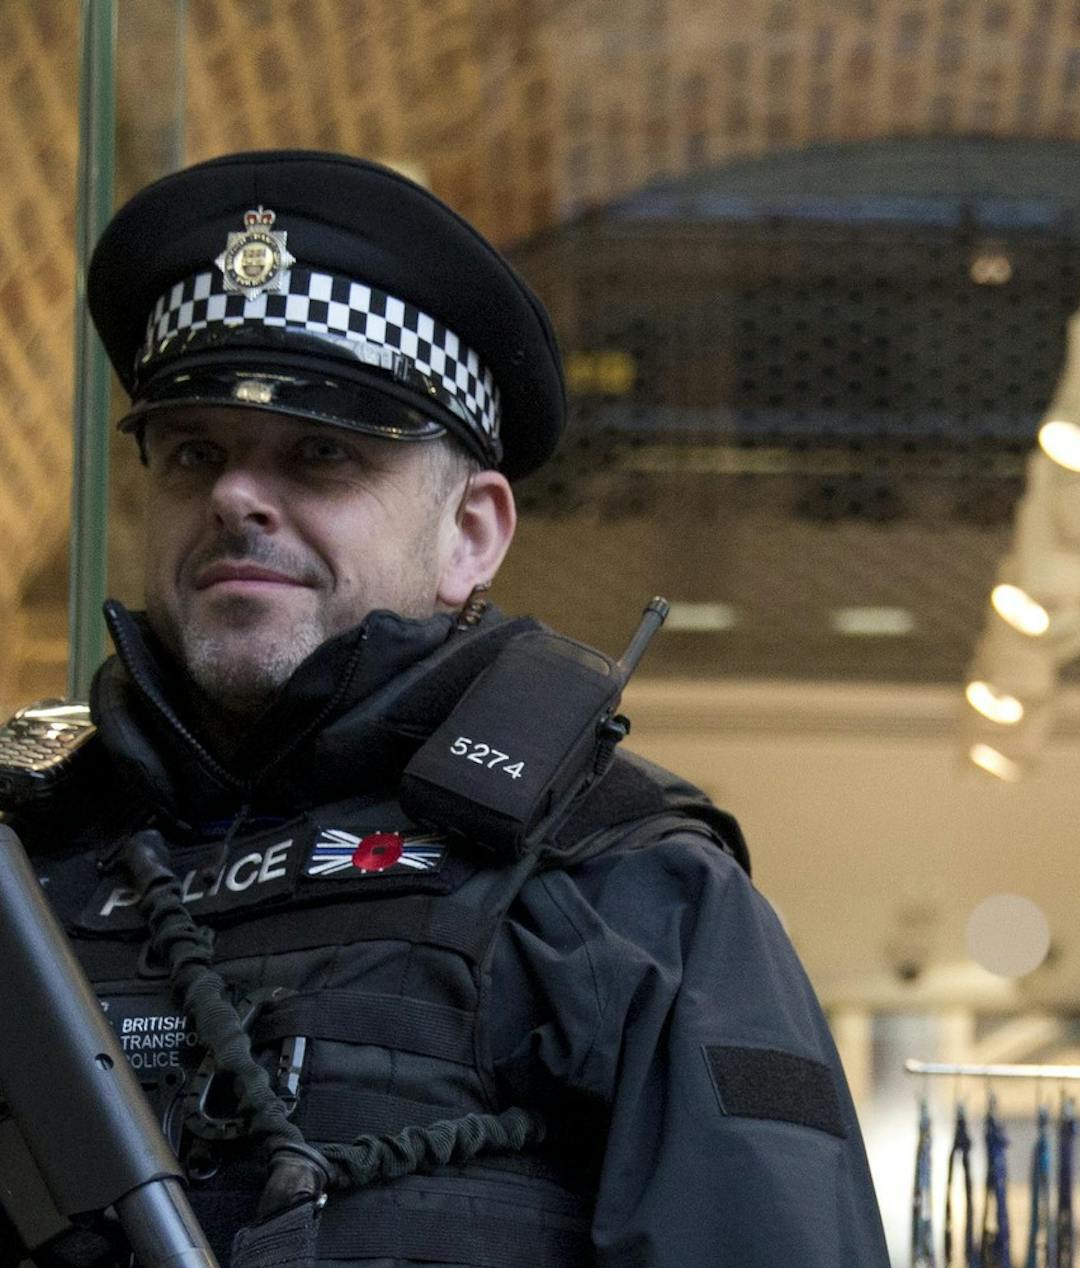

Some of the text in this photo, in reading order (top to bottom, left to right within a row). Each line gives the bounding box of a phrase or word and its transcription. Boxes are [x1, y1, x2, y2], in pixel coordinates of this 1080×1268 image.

[449, 736, 525, 780] 5274
[99, 837, 295, 917] PLICE
[121, 1015, 188, 1034] BRITISH
[120, 1031, 199, 1051] TRANSPO
[127, 1050, 181, 1070] OLICE
